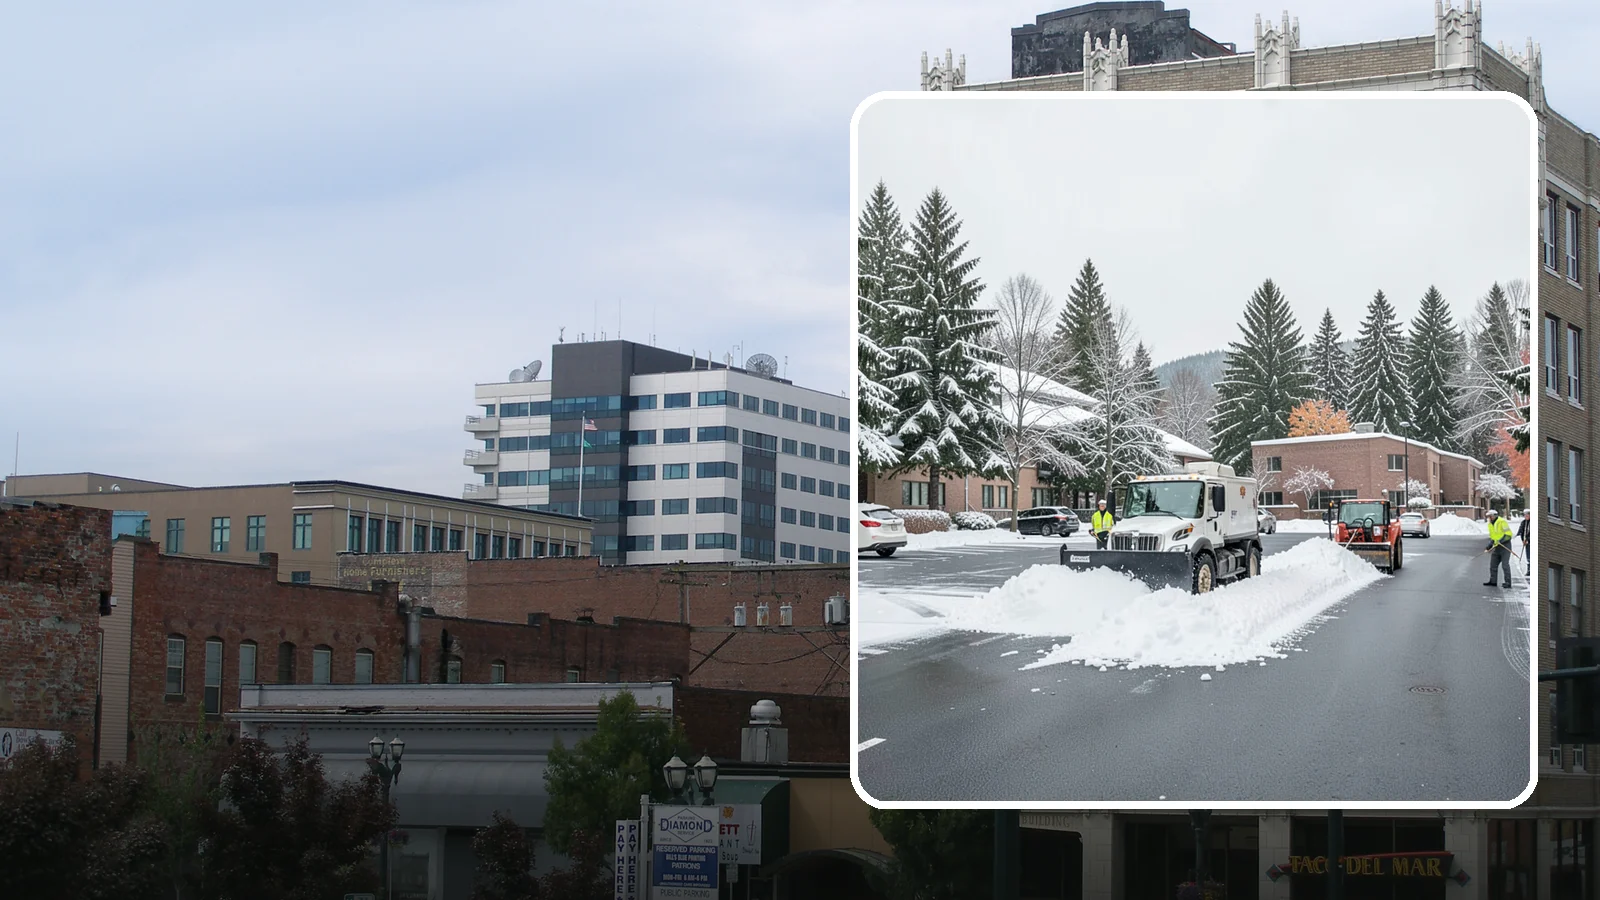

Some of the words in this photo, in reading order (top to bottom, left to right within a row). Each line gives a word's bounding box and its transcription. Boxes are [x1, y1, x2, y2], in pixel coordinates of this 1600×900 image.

[370, 566, 427, 577] Furnishers
[660, 818, 713, 833] DIAMOND
[1021, 815, 1070, 827] BUILDING
[617, 825, 625, 853] PAY
[628, 824, 636, 853] PAY
[655, 845, 688, 853] RESERVED
[689, 846, 716, 854] PARKING
[721, 851, 739, 862] Soup
[671, 862, 701, 870] PATRONS
[1289, 855, 1329, 875] TAC
[1345, 856, 1384, 876] DEL
[1392, 857, 1442, 877] MAR
[616, 856, 625, 893] HERE
[627, 855, 636, 893] HERE
[660, 888, 682, 897] PUBLIC
[684, 889, 710, 899] PARKING
